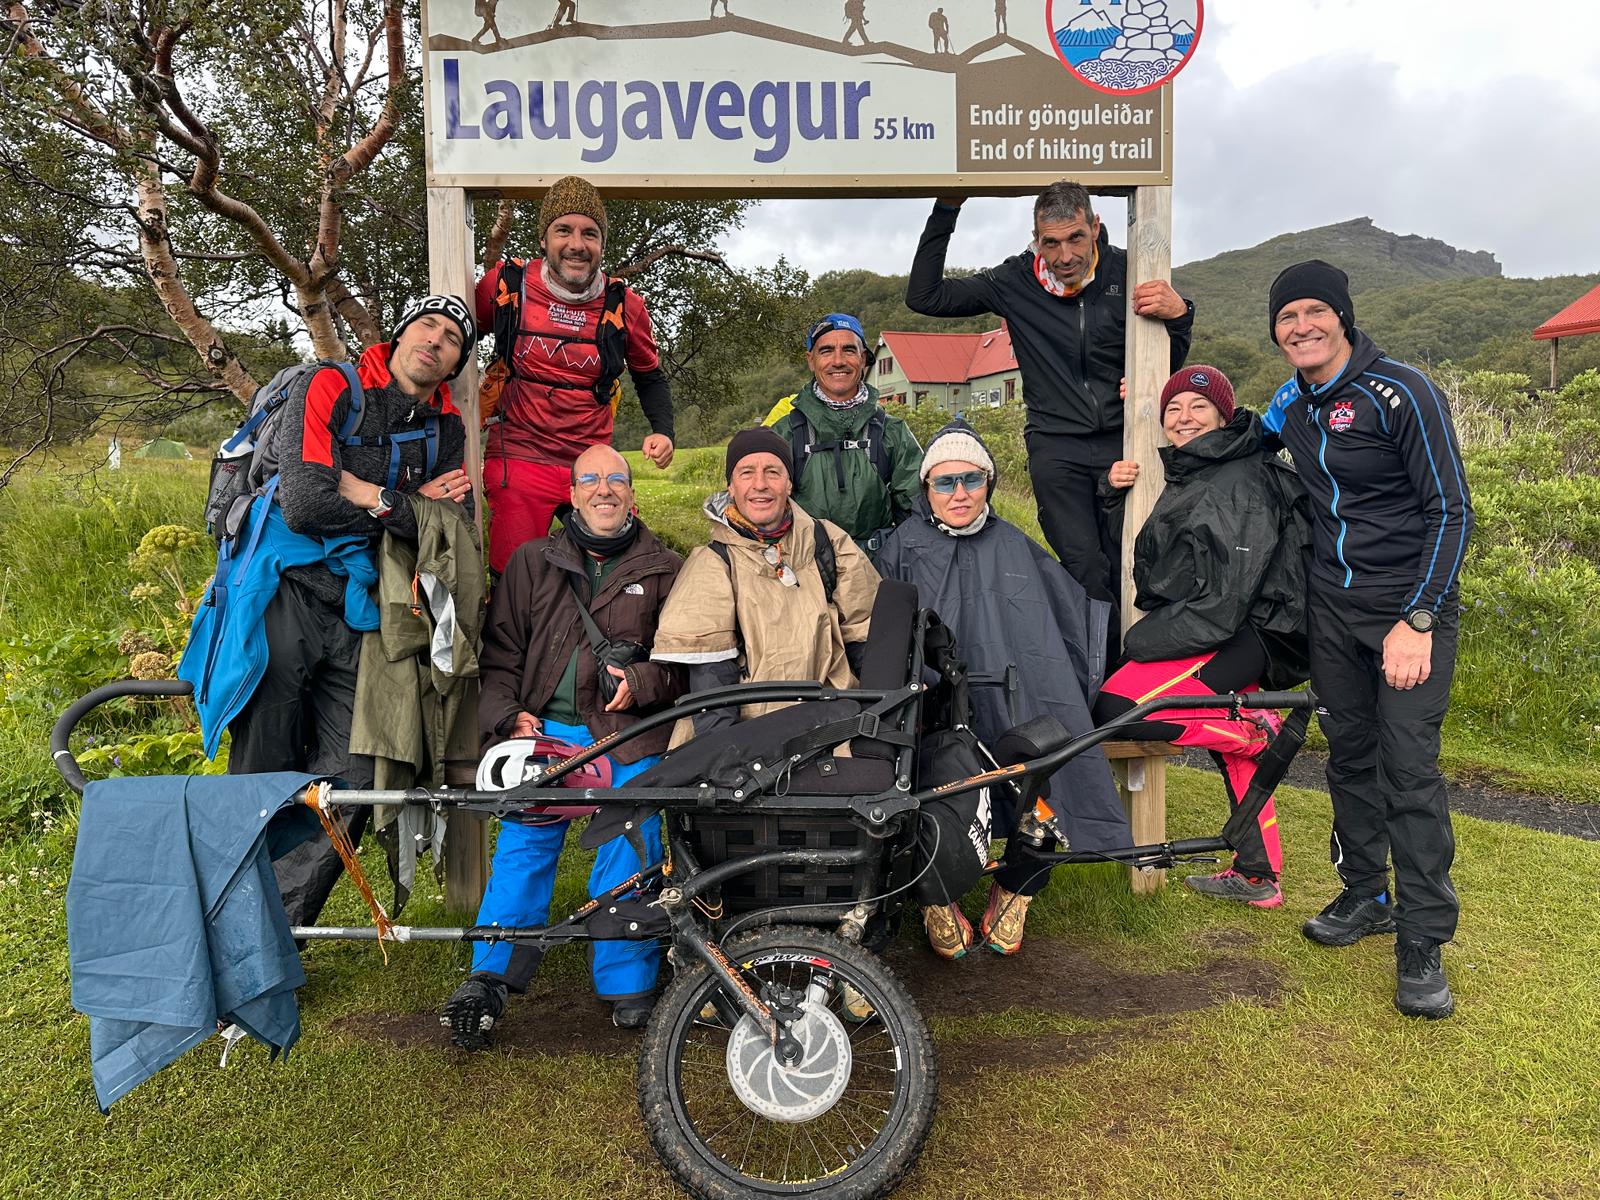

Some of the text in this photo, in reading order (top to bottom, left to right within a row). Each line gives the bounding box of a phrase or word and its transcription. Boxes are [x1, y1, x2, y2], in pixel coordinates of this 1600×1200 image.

[443, 58, 935, 163] Laugavegur 55 km
[970, 103, 1154, 131] Endir gönguleiðar
[970, 137, 1153, 165] End of hiking trail
